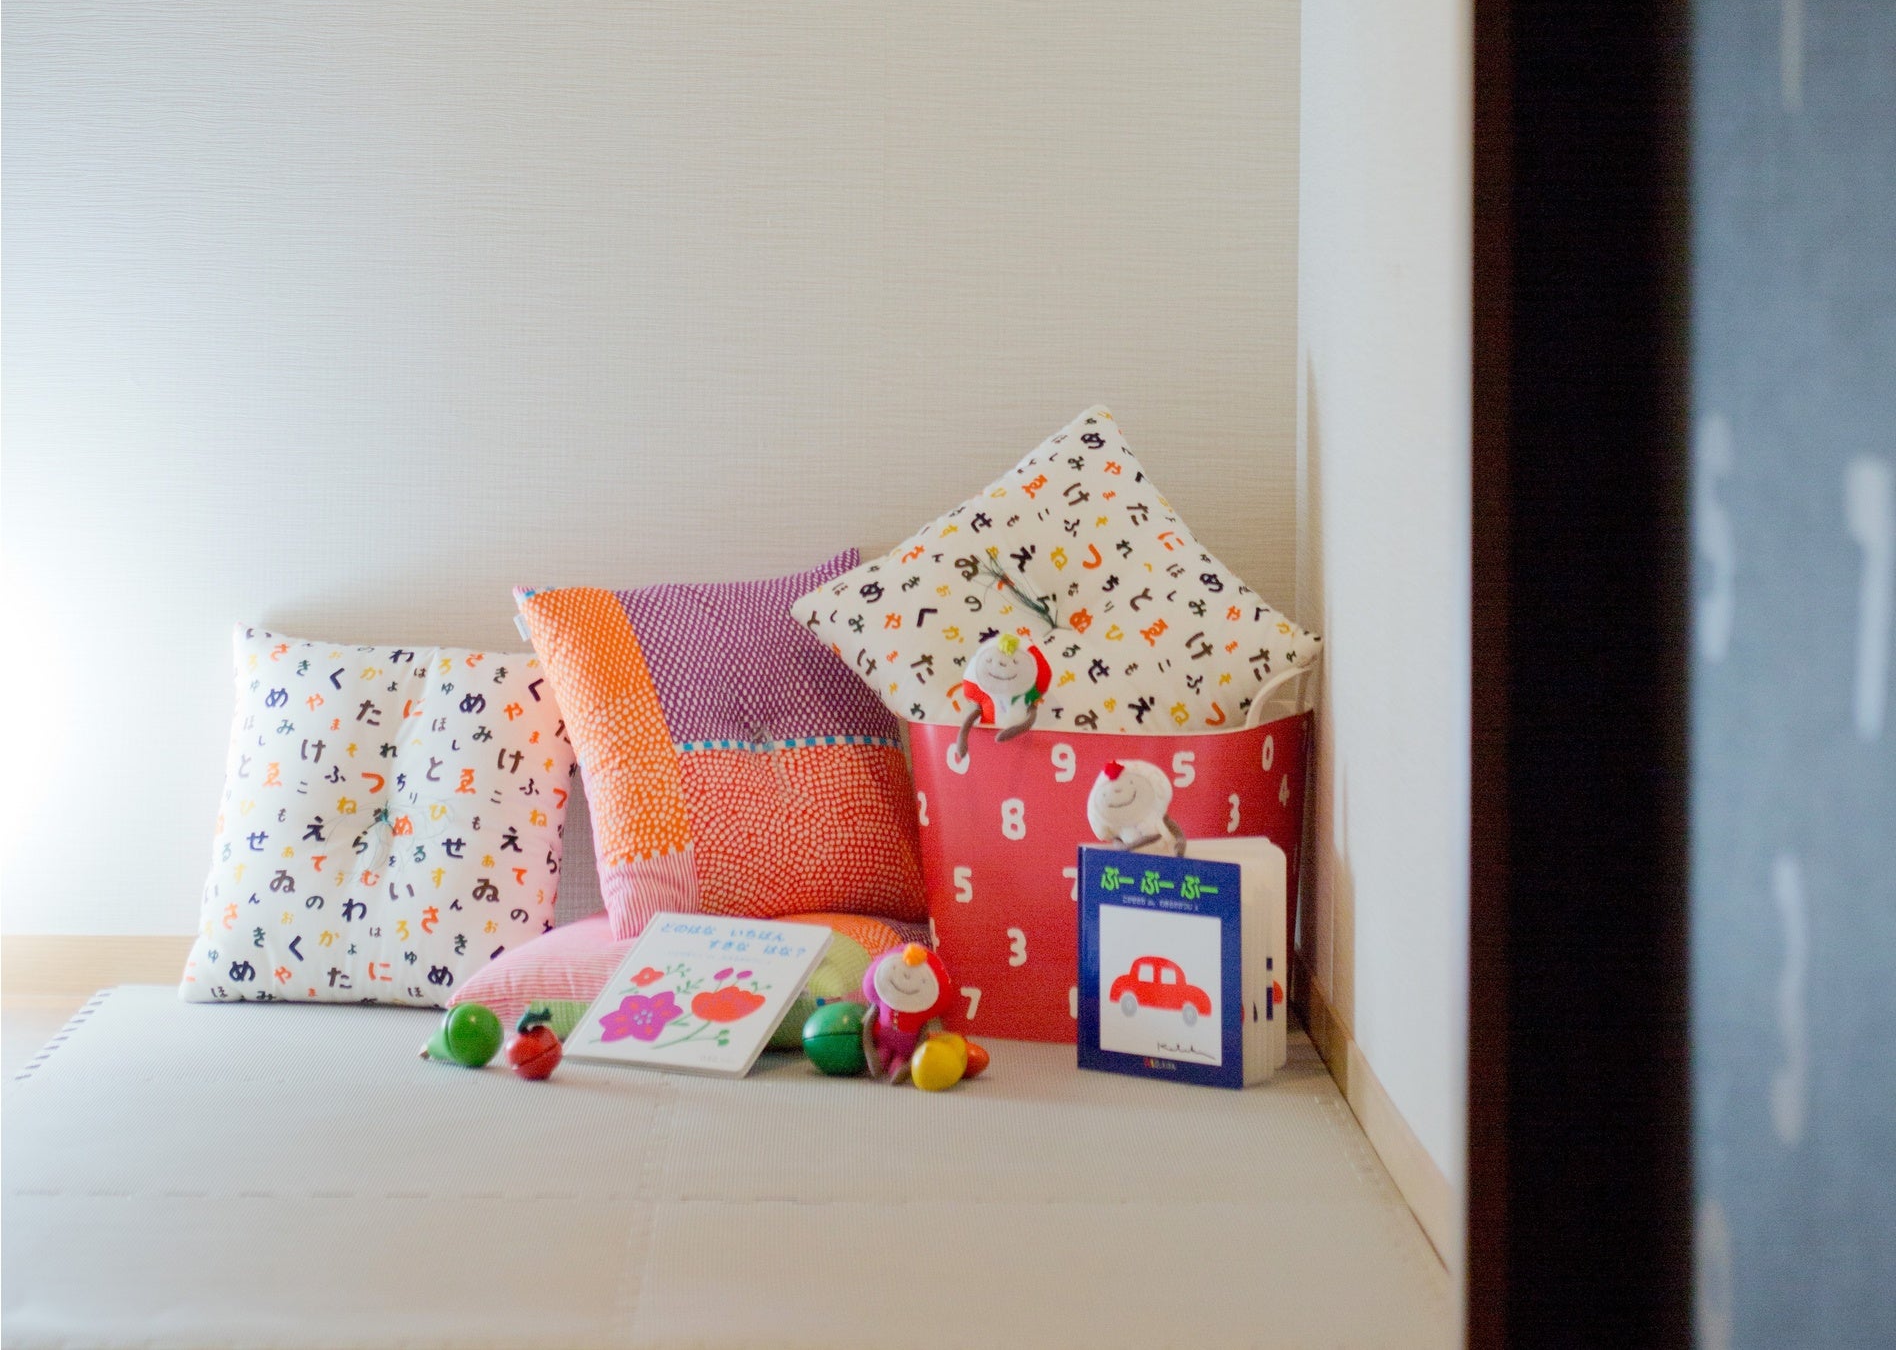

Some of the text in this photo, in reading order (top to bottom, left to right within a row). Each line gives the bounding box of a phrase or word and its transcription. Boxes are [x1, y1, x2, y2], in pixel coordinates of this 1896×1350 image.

[1010, 545, 1035, 573] え
[297, 660, 310, 676] き
[360, 666, 383, 681] か
[493, 667, 508, 684] き
[330, 668, 345, 690] く
[265, 688, 288, 707] め
[528, 678, 544, 702] く
[306, 693, 324, 711] や
[459, 693, 486, 714] め
[504, 702, 524, 721] や
[1128, 696, 1155, 724] え
[356, 700, 382, 726] た
[277, 719, 295, 735] み
[472, 726, 493, 743] み
[301, 739, 326, 763] け
[380, 743, 397, 758] れ
[452, 740, 460, 751] し
[1262, 735, 1274, 771] 0
[426, 756, 443, 782] と
[497, 748, 524, 774] け
[1051, 743, 1076, 783] 9
[1172, 751, 1196, 788] 5
[325, 765, 346, 783] ふ
[362, 772, 385, 794] つ
[519, 778, 539, 795] ふ
[337, 797, 357, 814] ね
[1227, 793, 1240, 833] 3
[530, 809, 547, 827] ね
[1001, 798, 1026, 840] 8
[303, 816, 325, 842] え
[500, 826, 522, 852] え
[247, 831, 269, 851] せ
[442, 838, 466, 859] せ
[312, 855, 327, 872] て
[360, 870, 380, 886] む
[512, 868, 527, 885] て
[954, 866, 973, 903] 5
[1062, 867, 1078, 901] 7
[249, 893, 260, 904] ん
[306, 895, 324, 909] の
[389, 882, 414, 901] い
[223, 903, 238, 930] さ
[342, 898, 367, 922] わ
[421, 906, 439, 934] さ
[510, 909, 529, 923] の
[254, 927, 265, 948] き
[320, 930, 339, 947] か
[397, 920, 410, 941] ろ
[289, 936, 304, 961] く
[454, 934, 467, 955] き
[1007, 927, 1027, 967] 3
[229, 961, 256, 981] め
[275, 966, 292, 984] や
[327, 967, 352, 989] た
[368, 962, 392, 981] に
[427, 965, 453, 987] め
[960, 987, 982, 1020] 7
